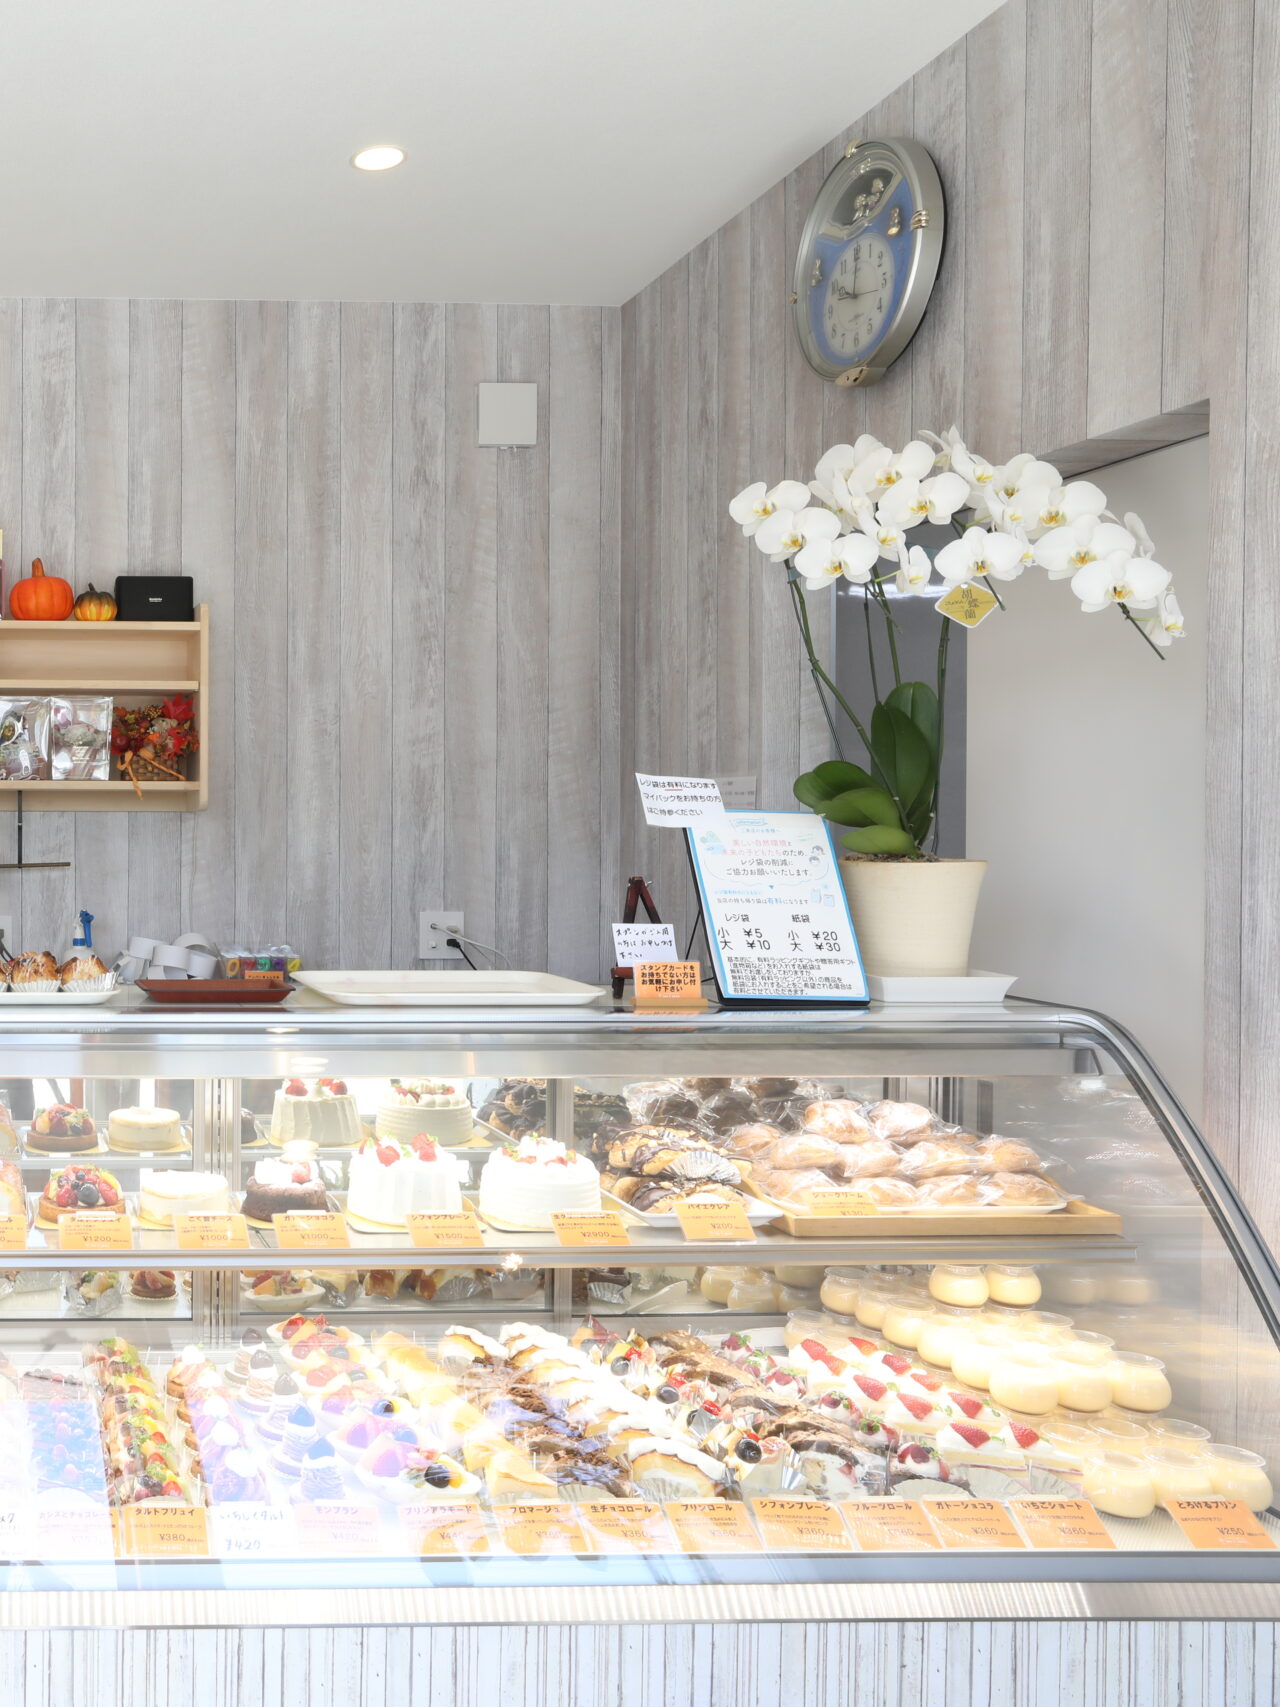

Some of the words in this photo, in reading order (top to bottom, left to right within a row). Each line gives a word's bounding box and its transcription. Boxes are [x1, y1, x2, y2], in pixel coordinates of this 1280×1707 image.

[639, 779, 717, 790] レジ袋は有料になります
[646, 806, 704, 816] はご持参ください
[740, 858, 794, 867] レジ袋の削減に
[725, 913, 750, 922] レジ袋
[791, 914, 810, 923] 紙袋
[718, 926, 730, 938] 小
[742, 928, 763, 939] ¥5
[788, 930, 799, 940] 小
[811, 931, 838, 941] ¥20
[720, 940, 733, 950] 大
[746, 940, 771, 950] ¥10
[790, 942, 803, 952] 大
[814, 942, 841, 952] ¥30
[655, 985, 683, 993] け下さい
[509, 1505, 562, 1514] フロマージュ
[590, 1504, 652, 1514] 生チョコロール
[680, 1503, 733, 1513] プリンロール
[759, 1500, 831, 1512] シフォンプレーン
[852, 1501, 912, 1512] フルーツロール
[935, 1500, 994, 1511] ガトーショコラ
[1022, 1500, 1083, 1511] いちごショート
[1176, 1499, 1237, 1511] とろけるプリン
[135, 1507, 196, 1518] タルトフリュイ
[158, 1532, 185, 1543] ¥380
[224, 1537, 261, 1551] ¥420
